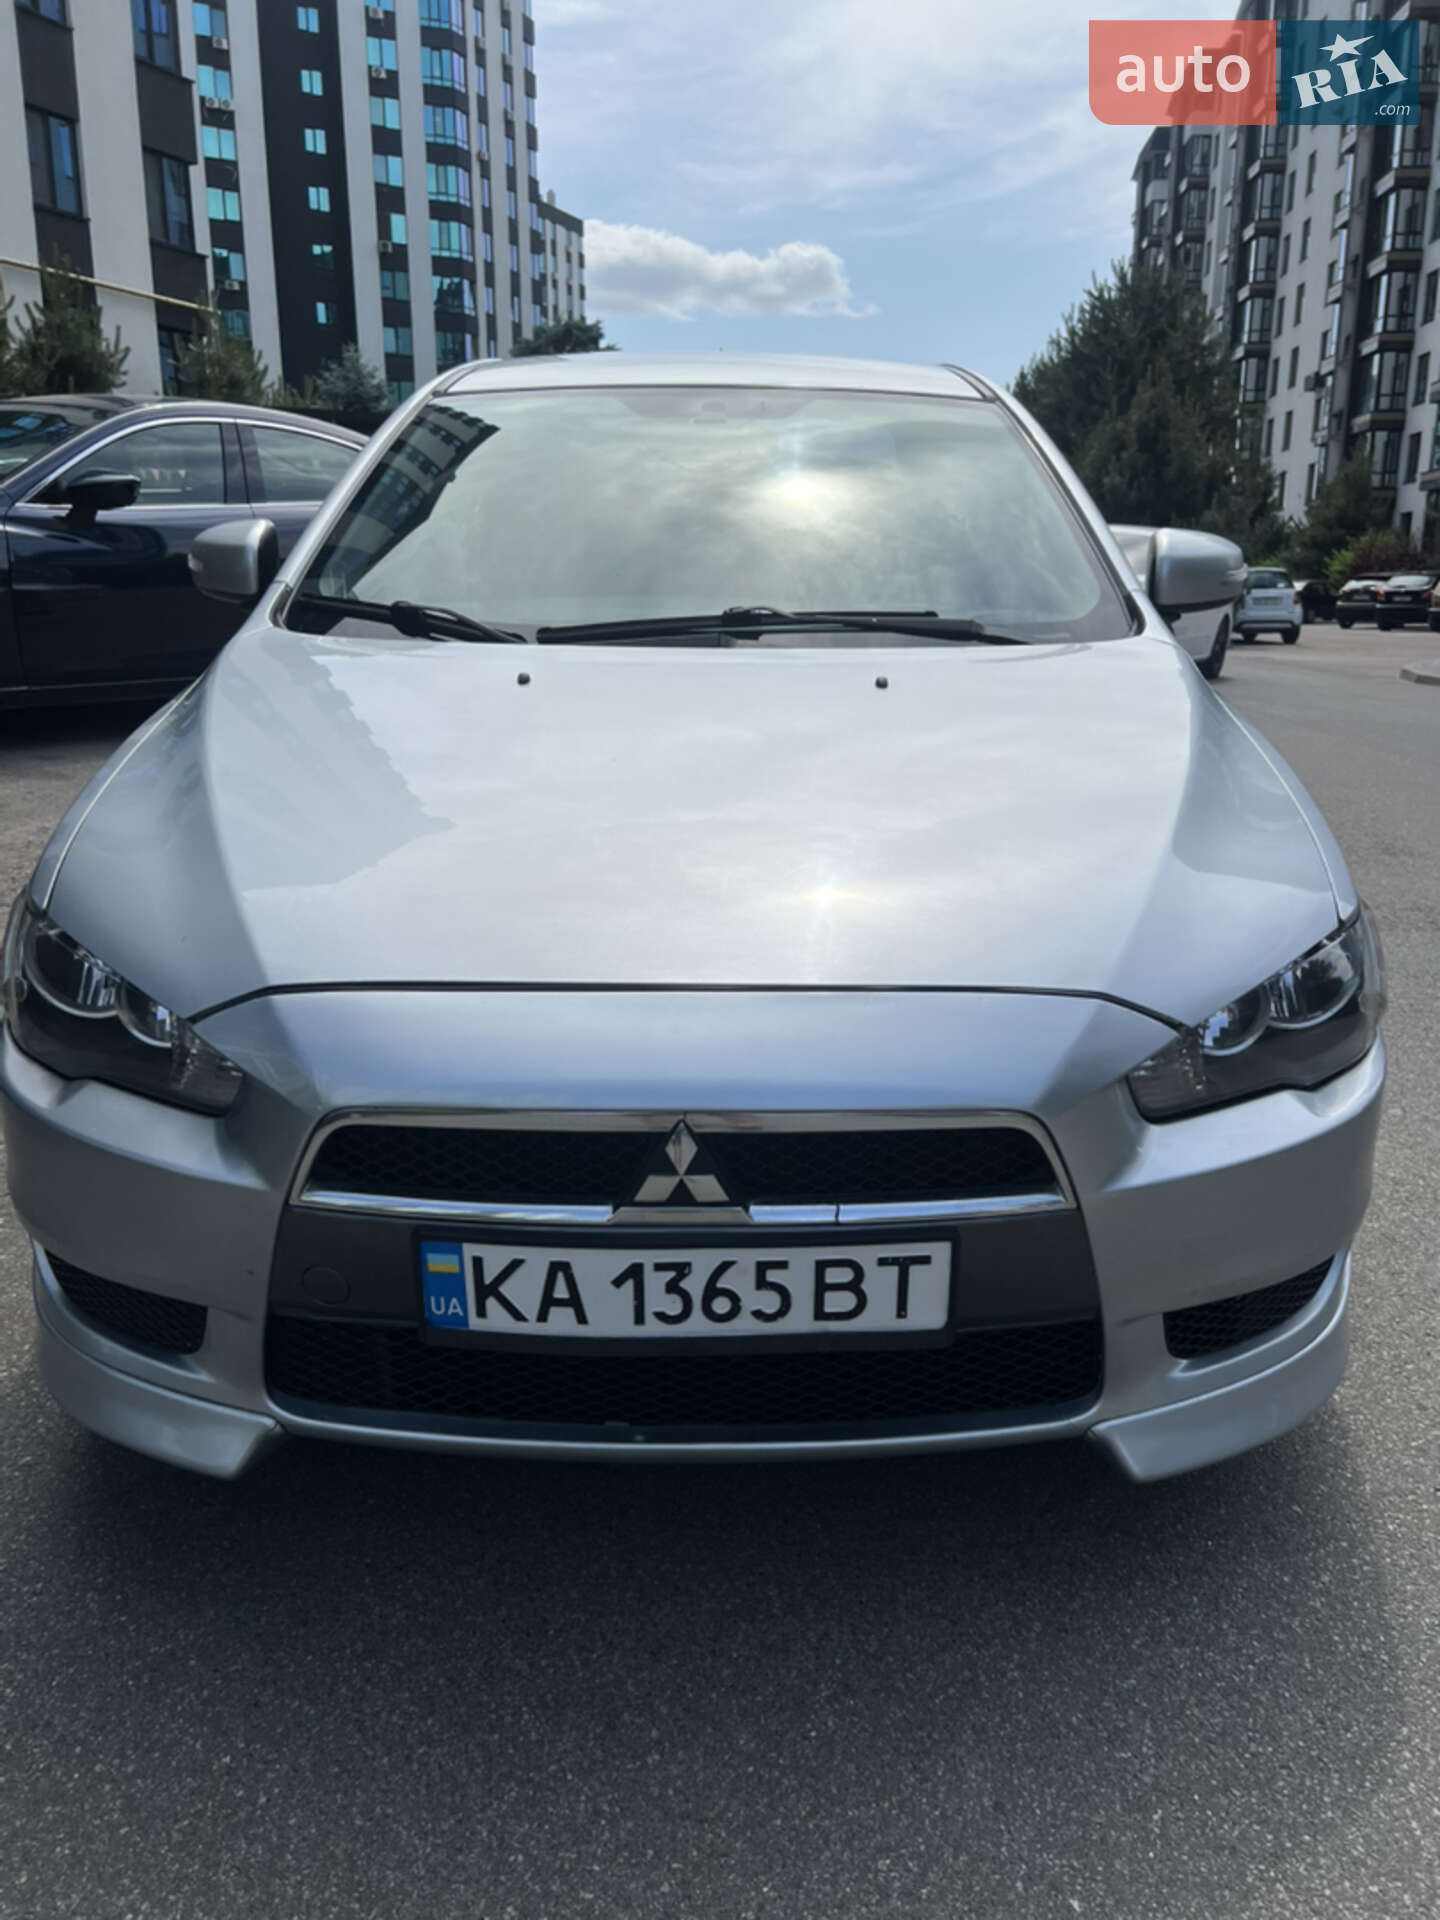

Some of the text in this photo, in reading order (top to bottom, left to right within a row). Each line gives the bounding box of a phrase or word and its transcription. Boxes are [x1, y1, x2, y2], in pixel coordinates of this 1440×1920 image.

[431, 1297, 464, 1317] UA
[472, 1255, 932, 1326] KA 1365 BT
